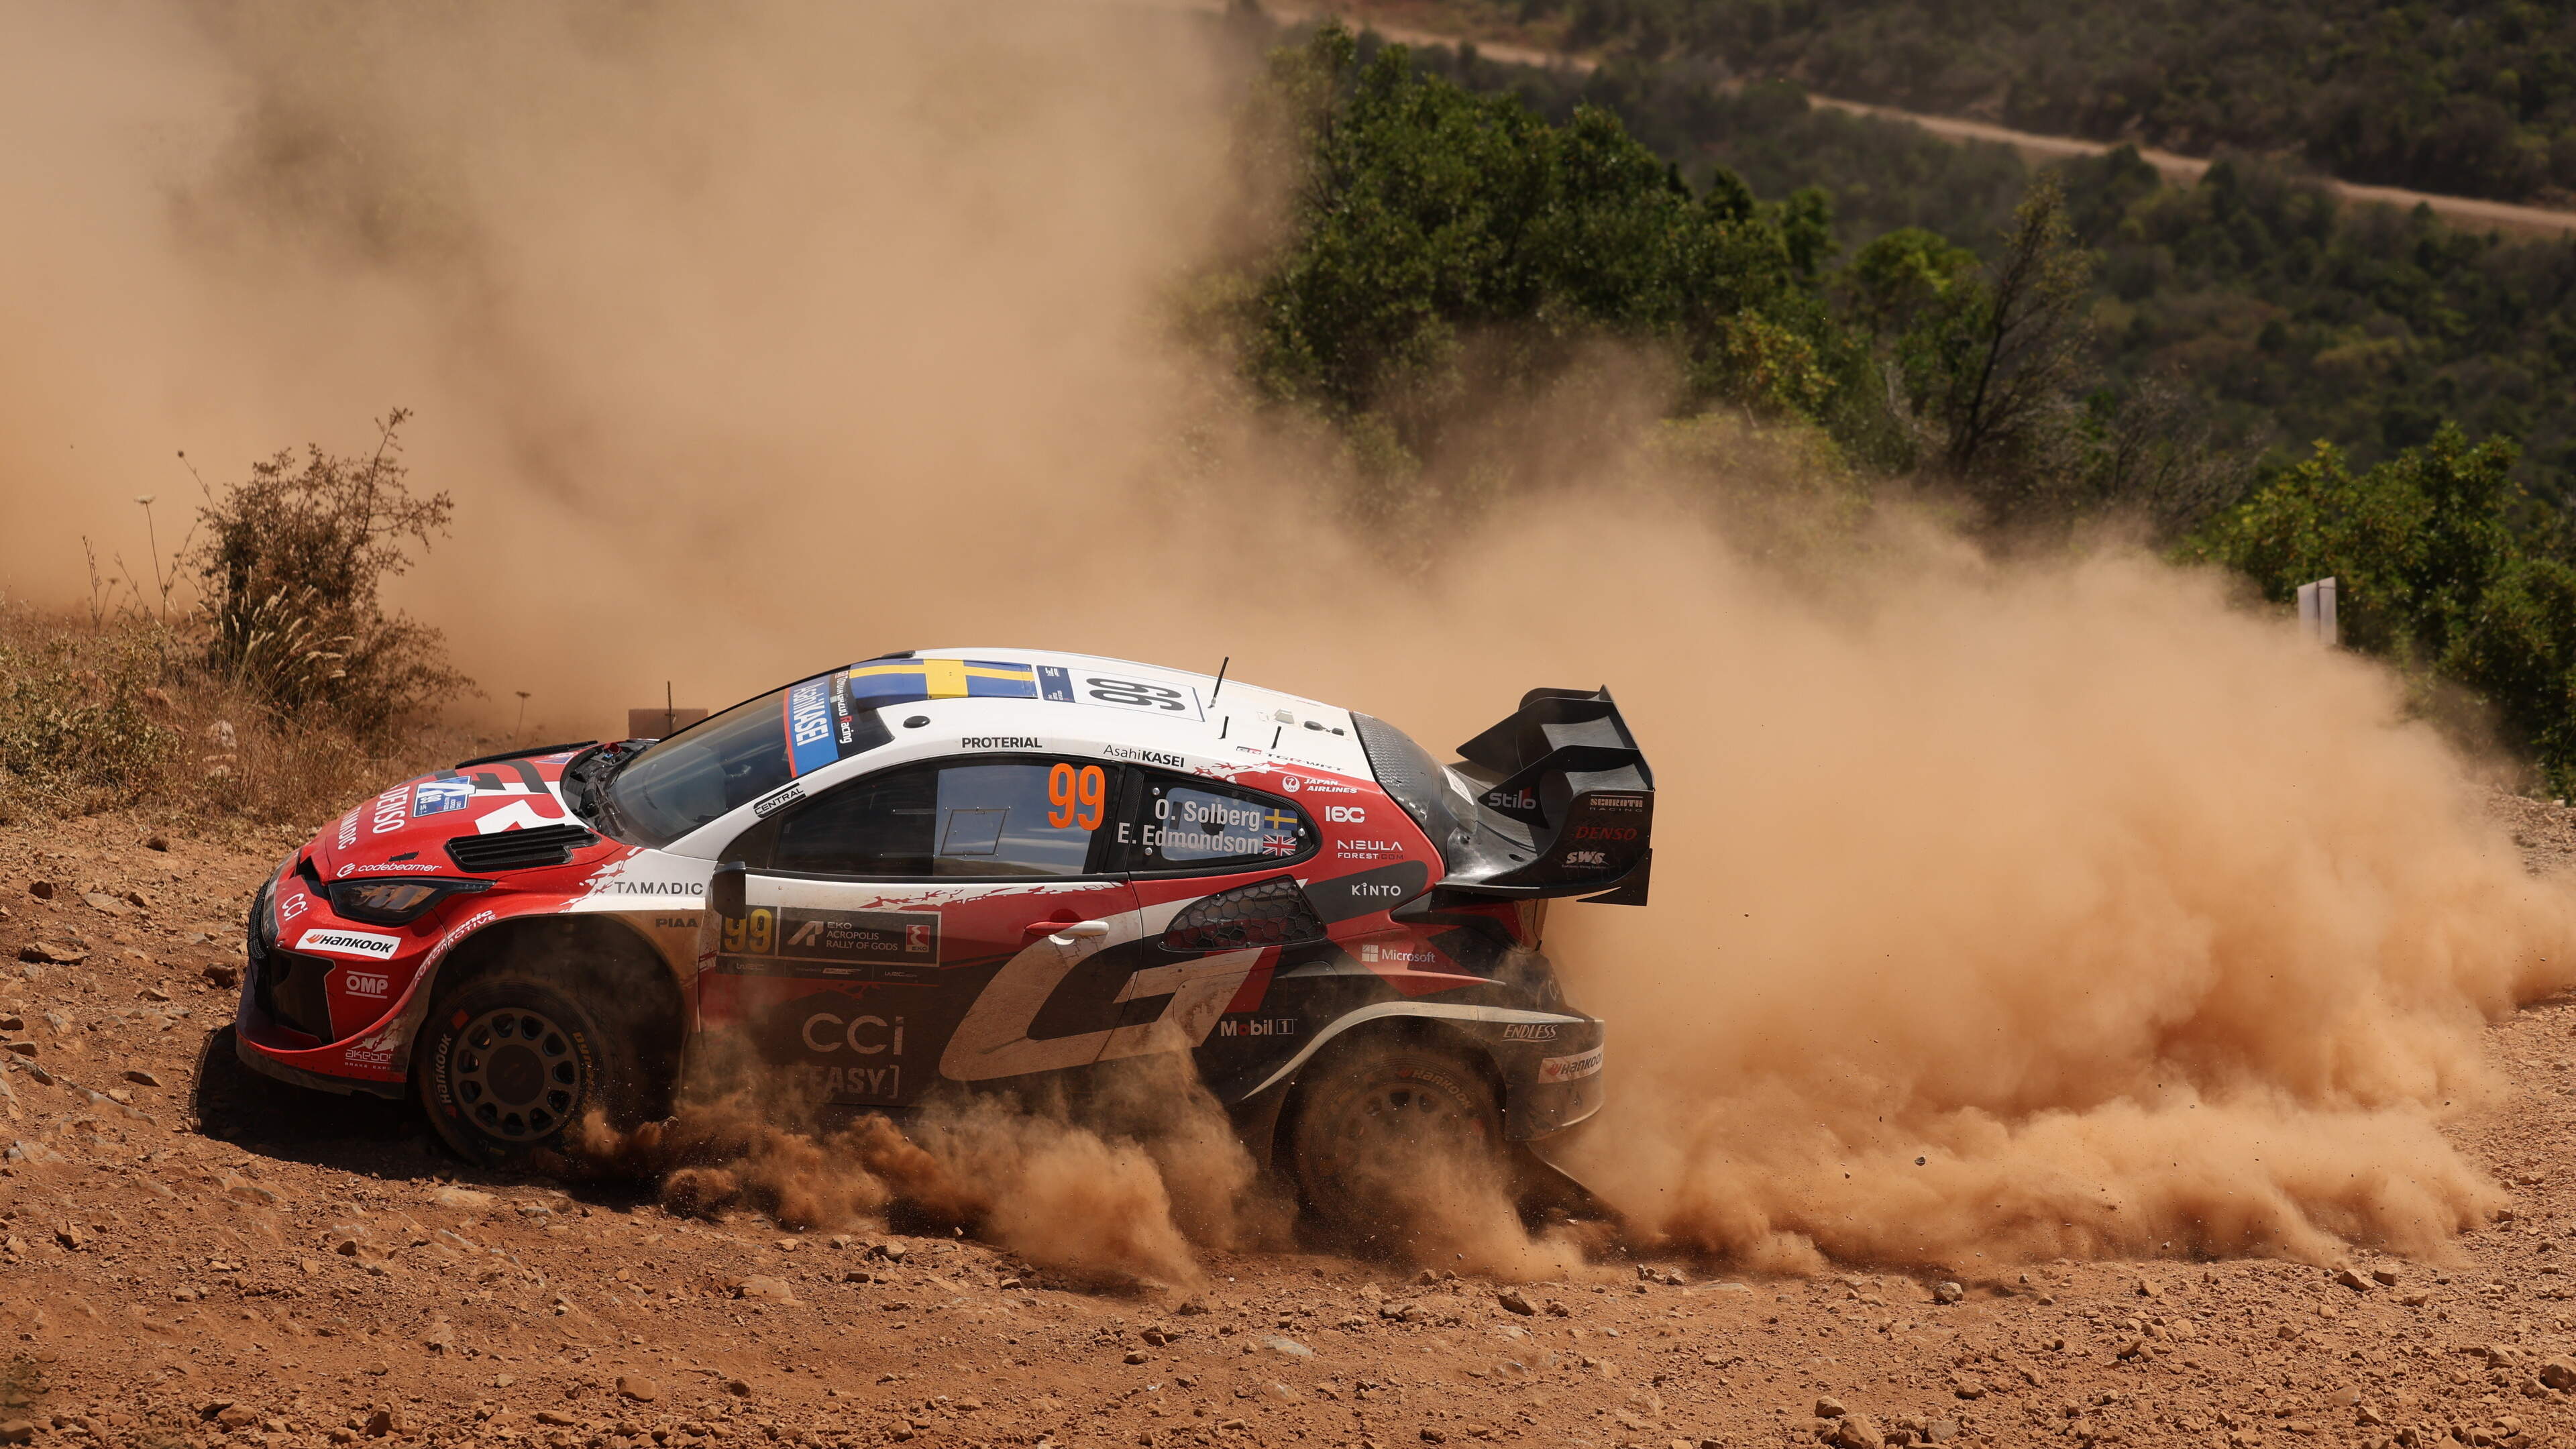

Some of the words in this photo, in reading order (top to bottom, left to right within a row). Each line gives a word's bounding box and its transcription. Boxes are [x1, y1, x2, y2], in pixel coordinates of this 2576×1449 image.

[1086, 678, 1186, 711] 99
[839, 715, 855, 744] Racing
[961, 737, 1042, 749] PROTERIAL
[1047, 762, 1106, 831] 99
[1307, 785, 1358, 793] AIRLINES
[754, 788, 804, 815] CENTRAL
[1489, 789, 1536, 810] Stilo
[1590, 798, 1643, 808] SCHROTH
[372, 786, 410, 834] DENSO
[1155, 798, 1176, 820] O.
[1183, 802, 1260, 833] Solberg
[1117, 822, 1137, 845] E.
[1142, 824, 1259, 855] Edmondson
[1575, 826, 1638, 841] DENSO
[358, 862, 440, 873] codebeamer
[614, 881, 704, 896] TAMADIC
[655, 918, 698, 928] PIAA
[724, 908, 772, 953] 99
[827, 922, 853, 930] EKO
[826, 930, 880, 941] ACROPOLIS
[826, 940, 855, 949] RALLY
[856, 941, 869, 950] OF
[871, 942, 898, 951] GODS
[1382, 949, 1436, 963] Microsoft
[346, 975, 388, 994] OMP
[1221, 1019, 1273, 1036] Mobil
